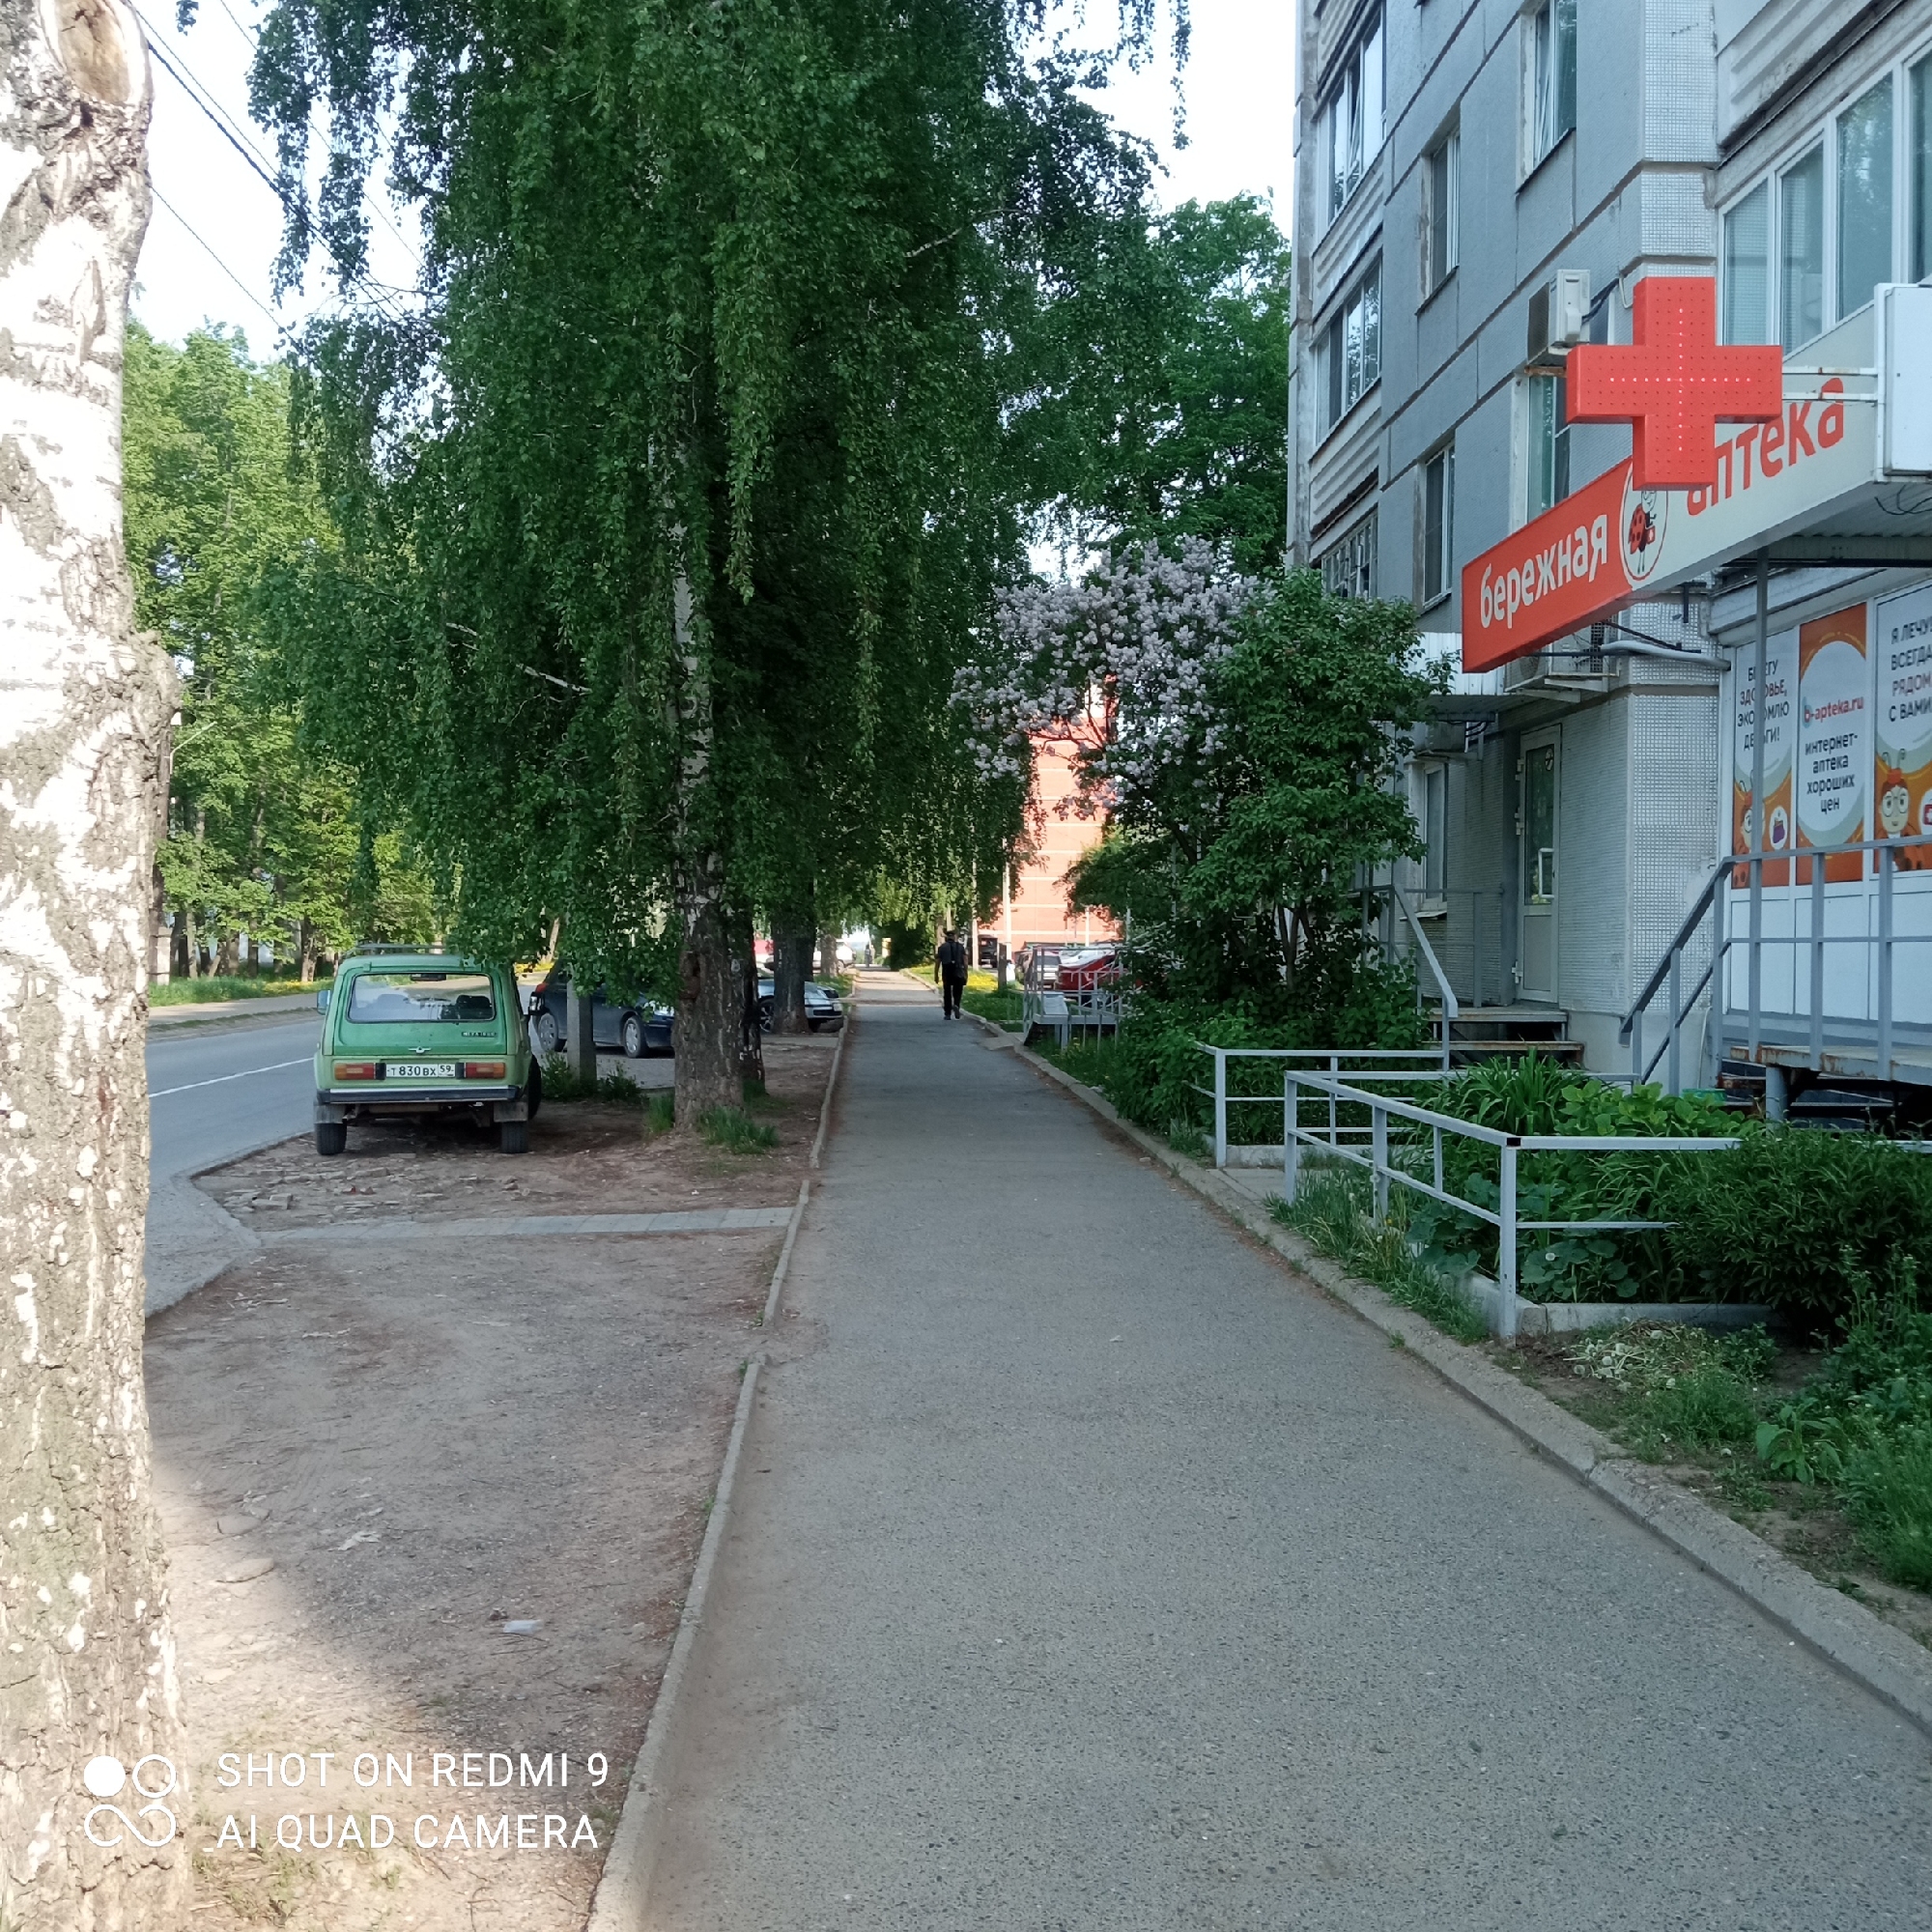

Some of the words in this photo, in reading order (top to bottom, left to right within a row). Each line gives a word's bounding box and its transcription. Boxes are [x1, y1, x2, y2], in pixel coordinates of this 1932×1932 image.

[1481, 515, 1607, 629] бережная
[1738, 701, 1789, 727] ЭКОМЛЮ
[1804, 696, 1864, 724] b-apteka.ru
[1889, 705, 1896, 722] С
[1744, 726, 1779, 752] ДЕГИ!
[1804, 733, 1859, 755] интернет-
[1813, 755, 1849, 774] аптека
[1806, 774, 1855, 797] хороших
[1820, 797, 1840, 815] цен
